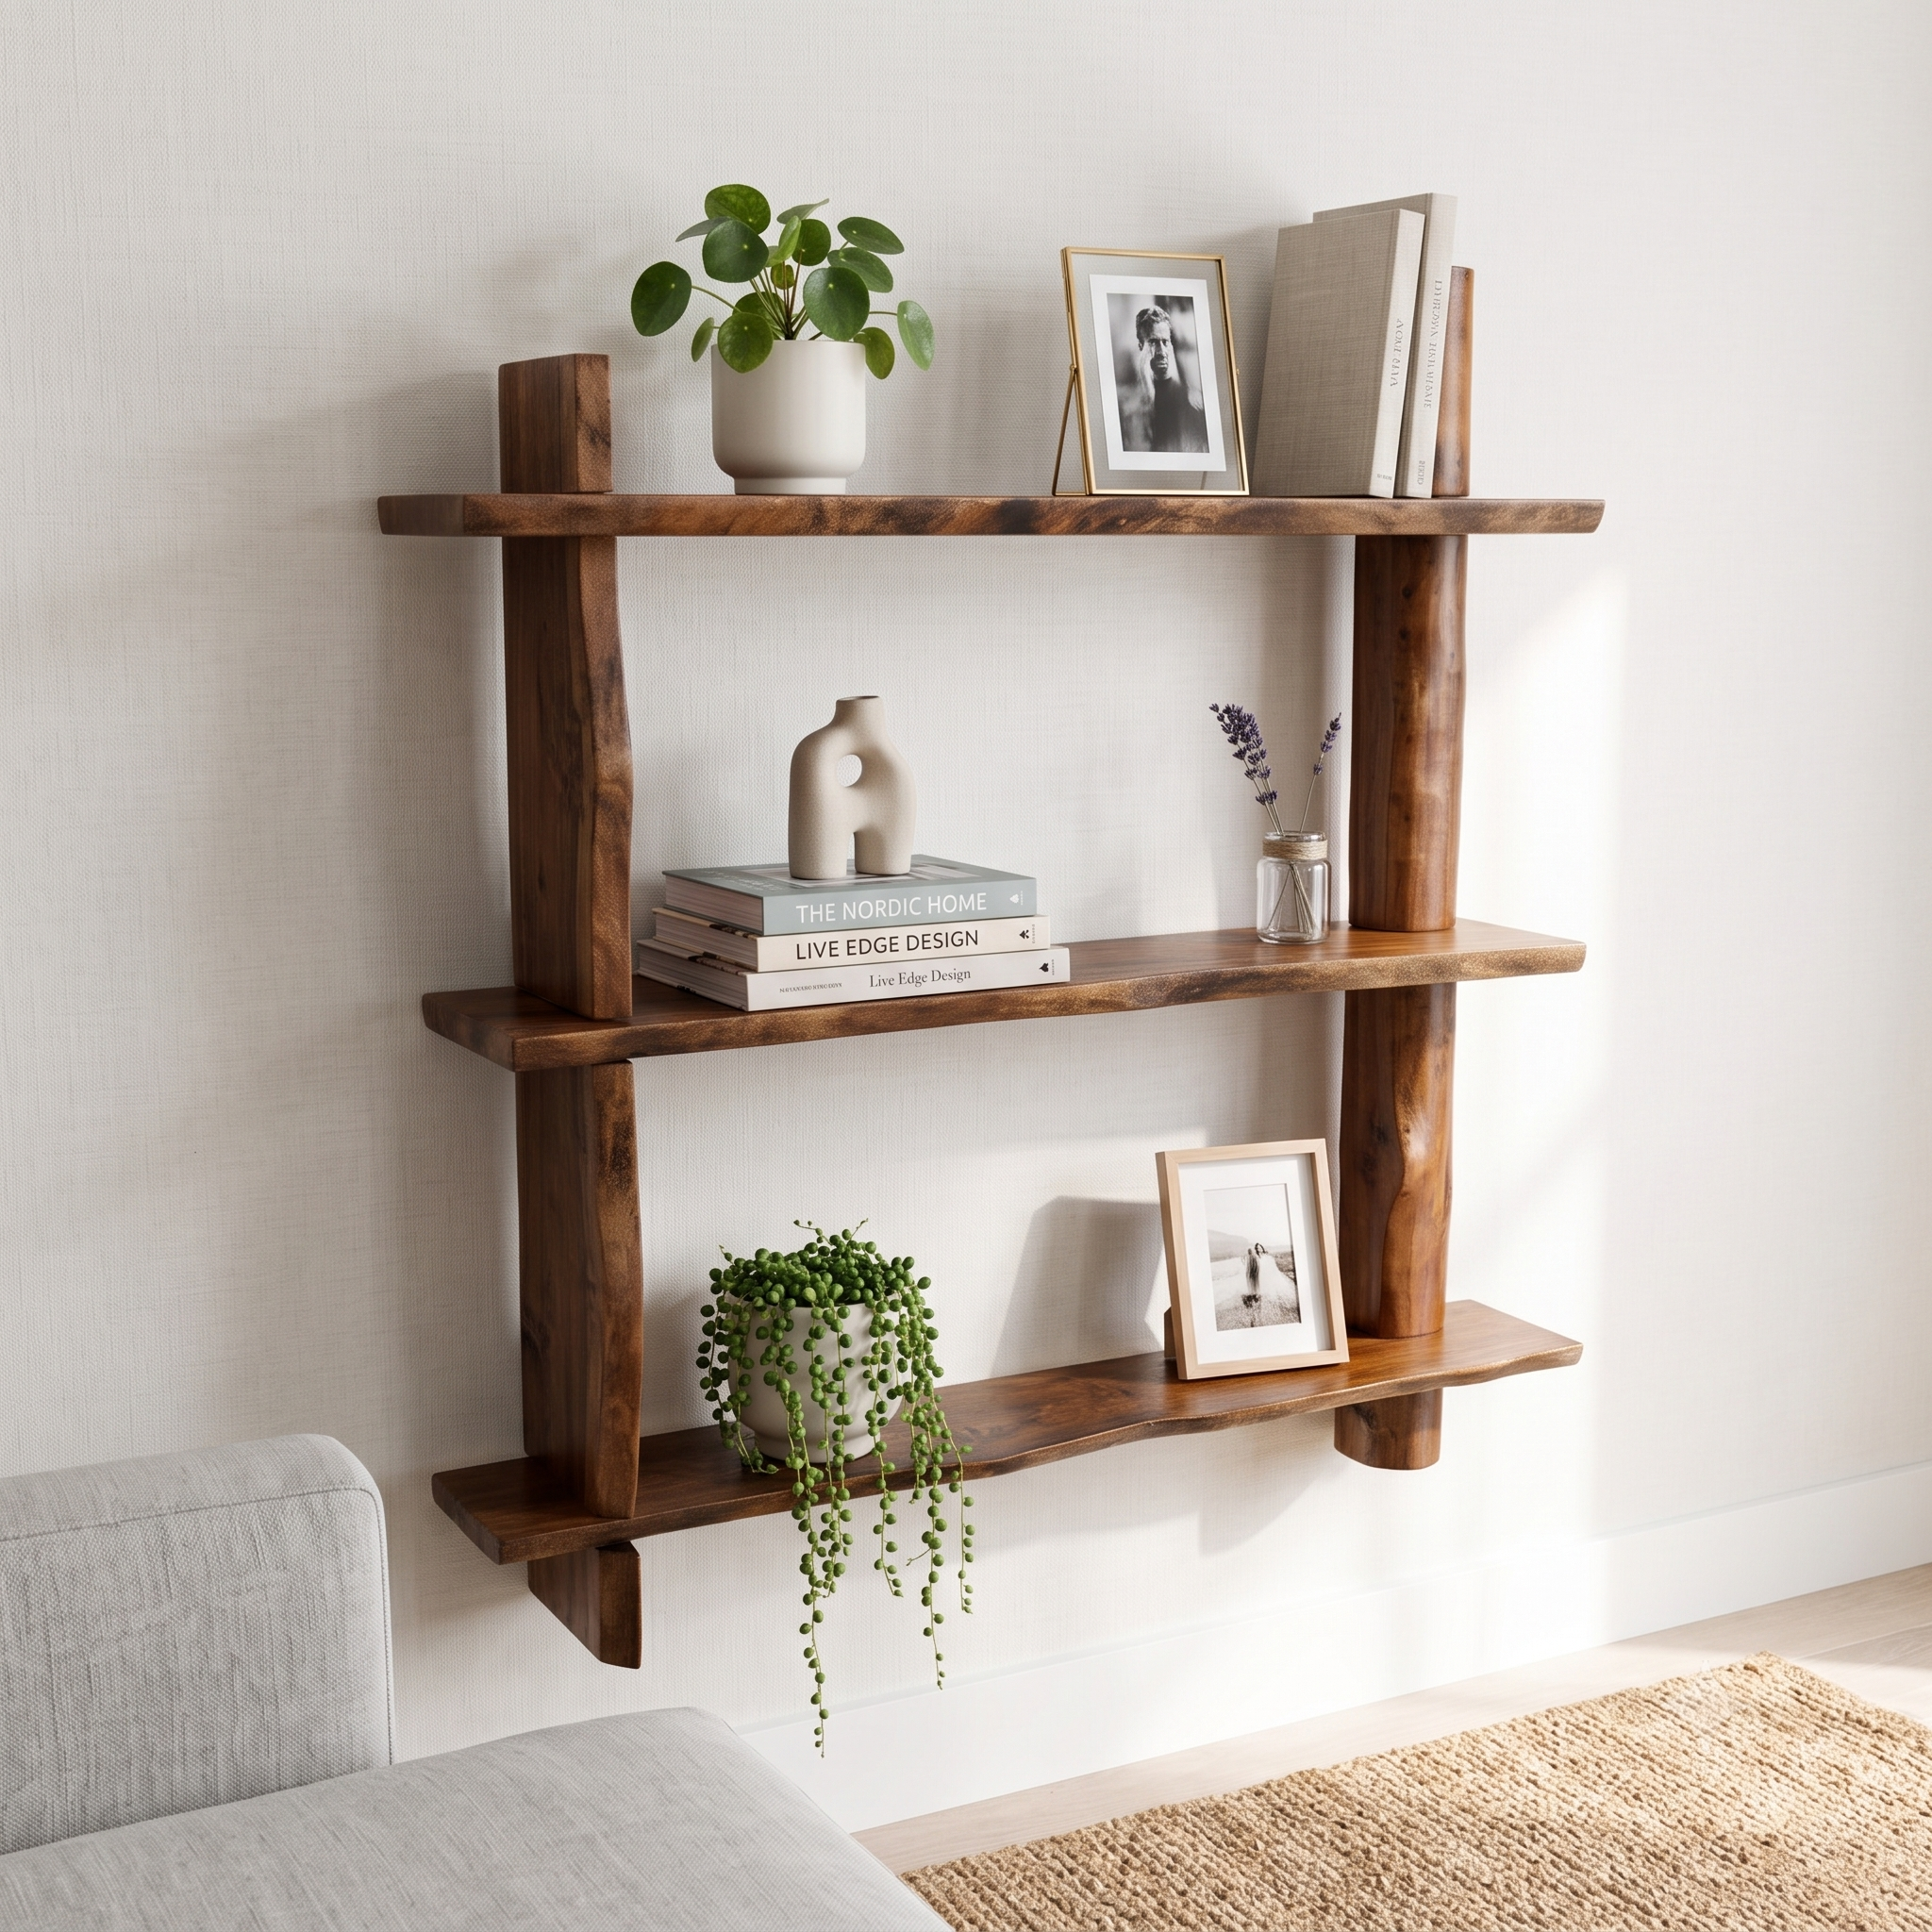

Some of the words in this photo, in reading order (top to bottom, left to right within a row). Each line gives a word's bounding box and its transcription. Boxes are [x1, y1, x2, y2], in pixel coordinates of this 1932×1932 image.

[795, 903, 836, 924] THE
[842, 896, 922, 921] NORDIC
[927, 892, 987, 915] HOME
[796, 940, 840, 960] LIVE
[846, 936, 900, 957] EDGE
[906, 929, 978, 952] DESIGN
[869, 974, 895, 988] Live
[898, 971, 928, 988] Edge
[931, 968, 971, 984] Design
